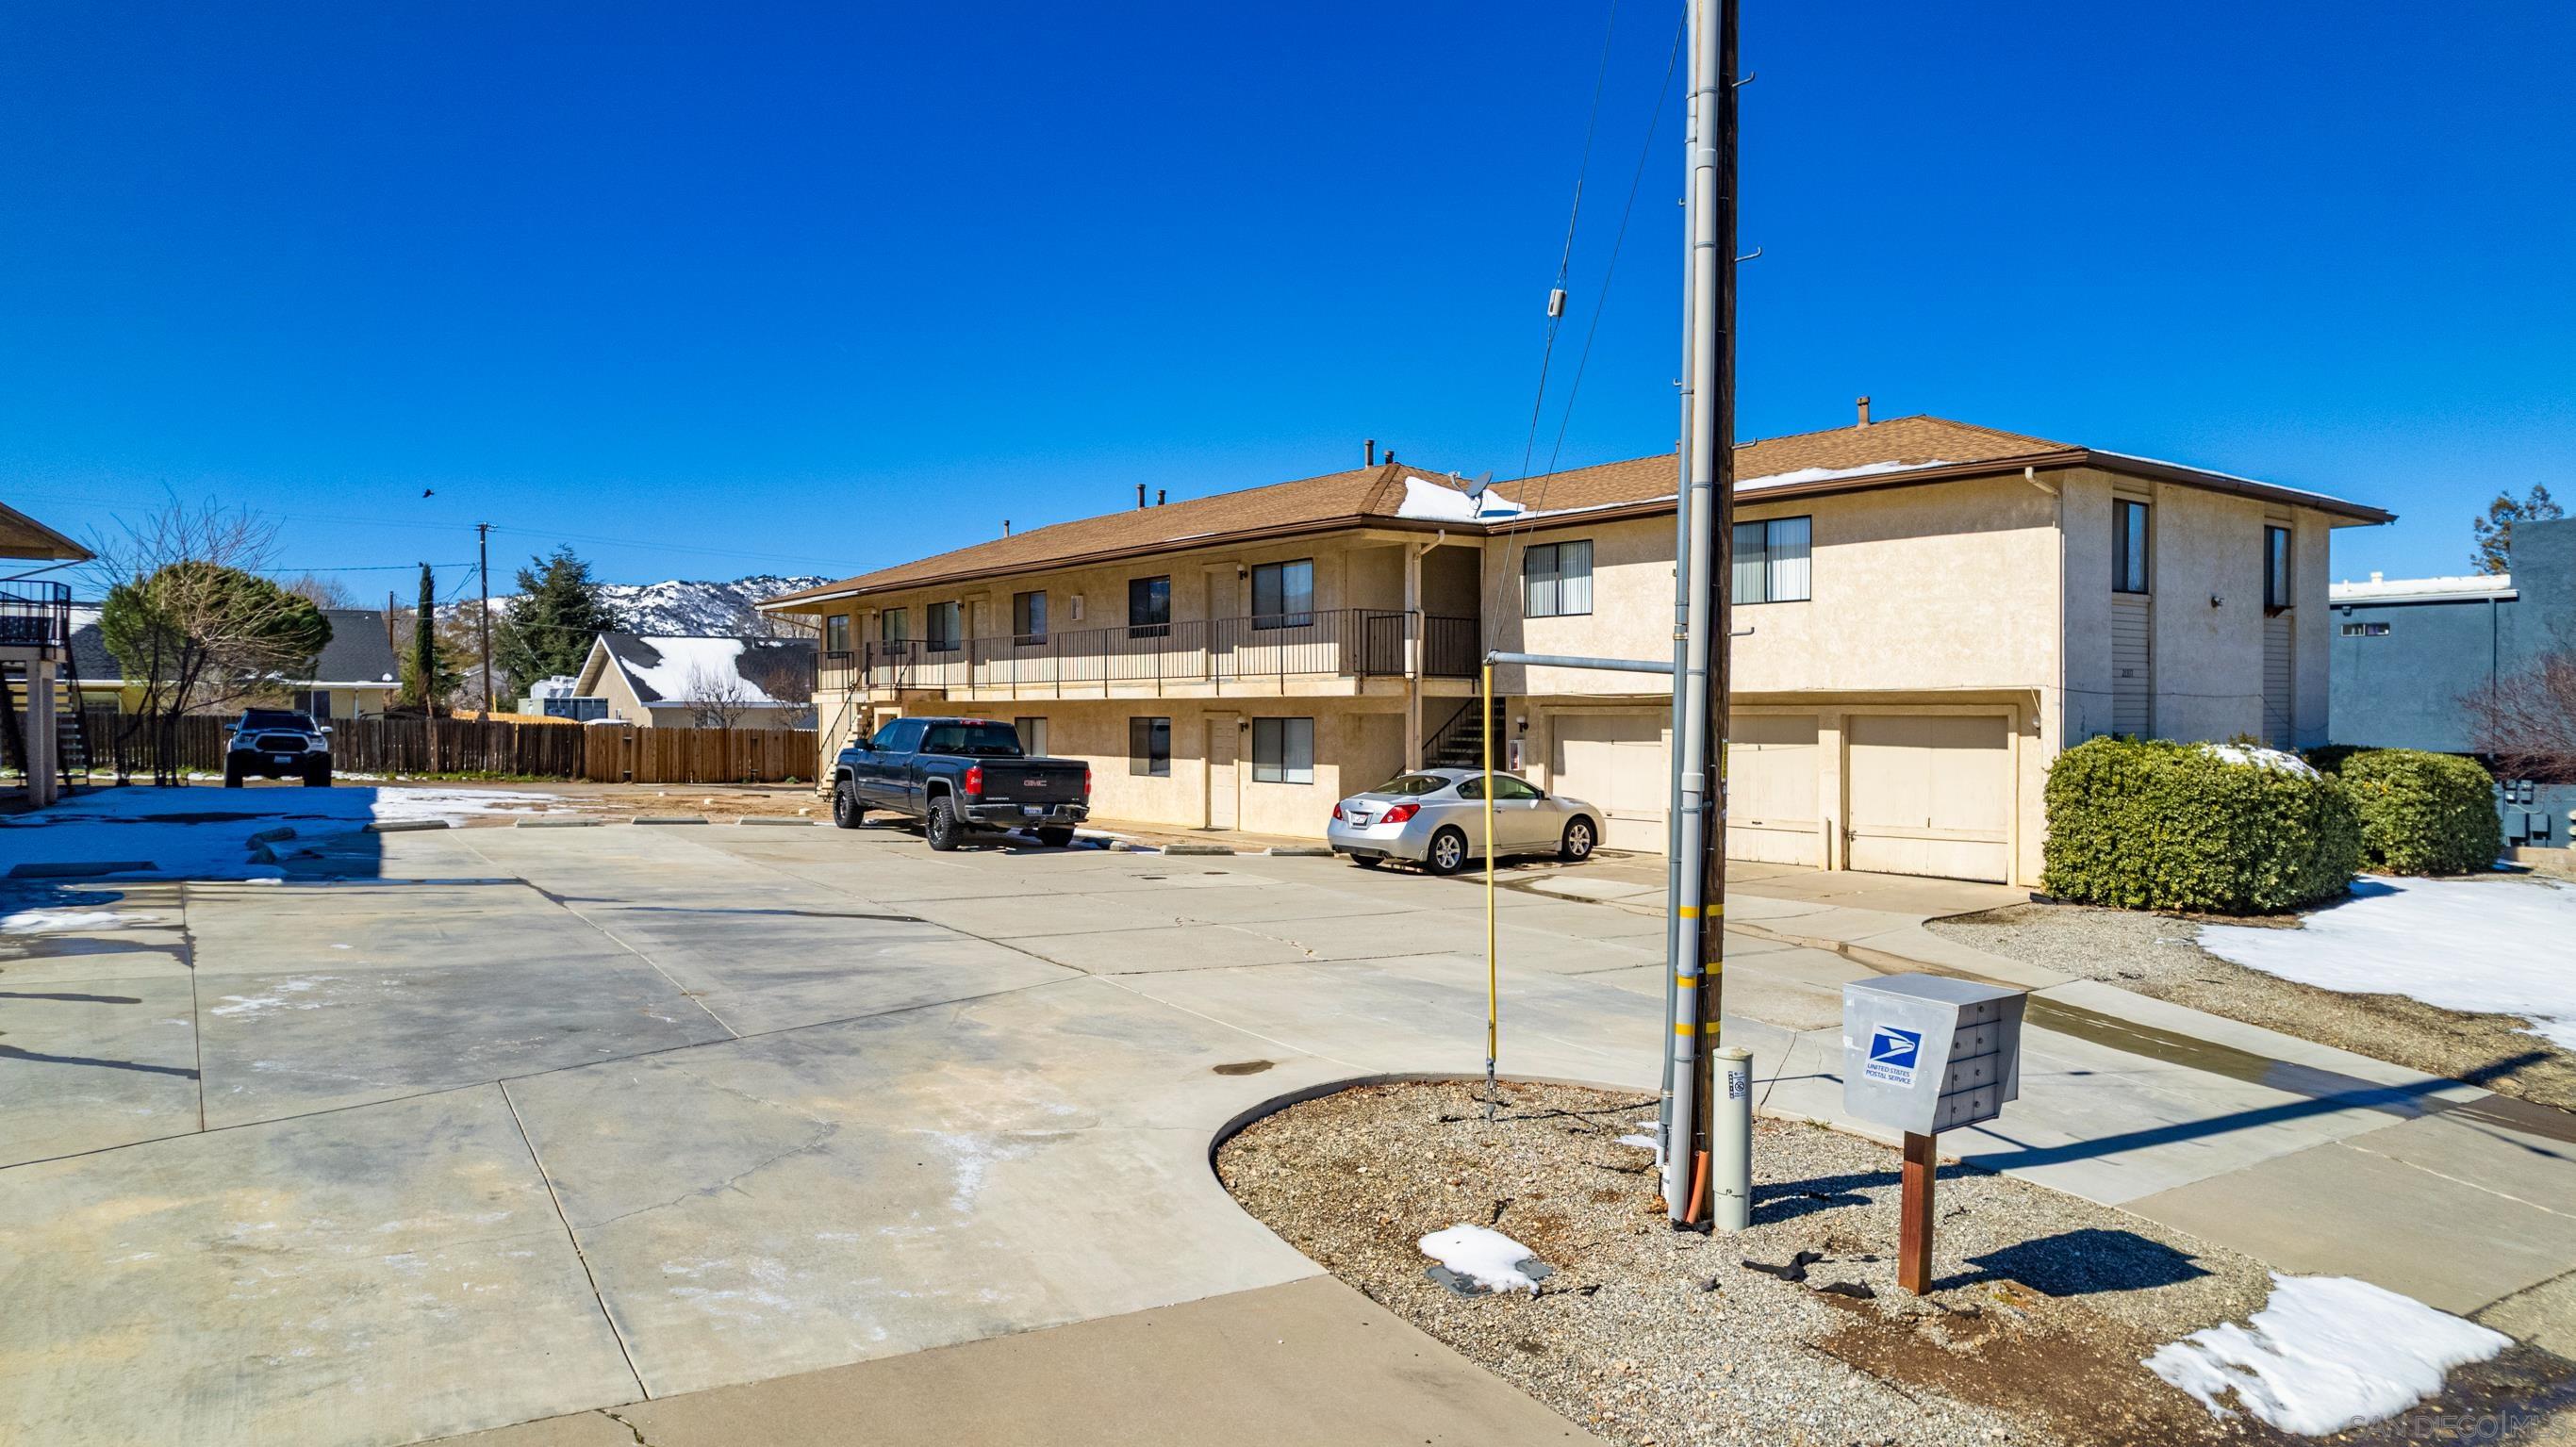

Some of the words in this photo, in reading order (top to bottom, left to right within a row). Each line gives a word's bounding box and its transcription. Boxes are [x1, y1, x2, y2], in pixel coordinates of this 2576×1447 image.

[1866, 1070, 1887, 1078] POSTAL
[1888, 1075, 1911, 1084] SERVICE
[1867, 1063, 1890, 1072] UNITED
[1890, 1068, 1910, 1077] STATES
